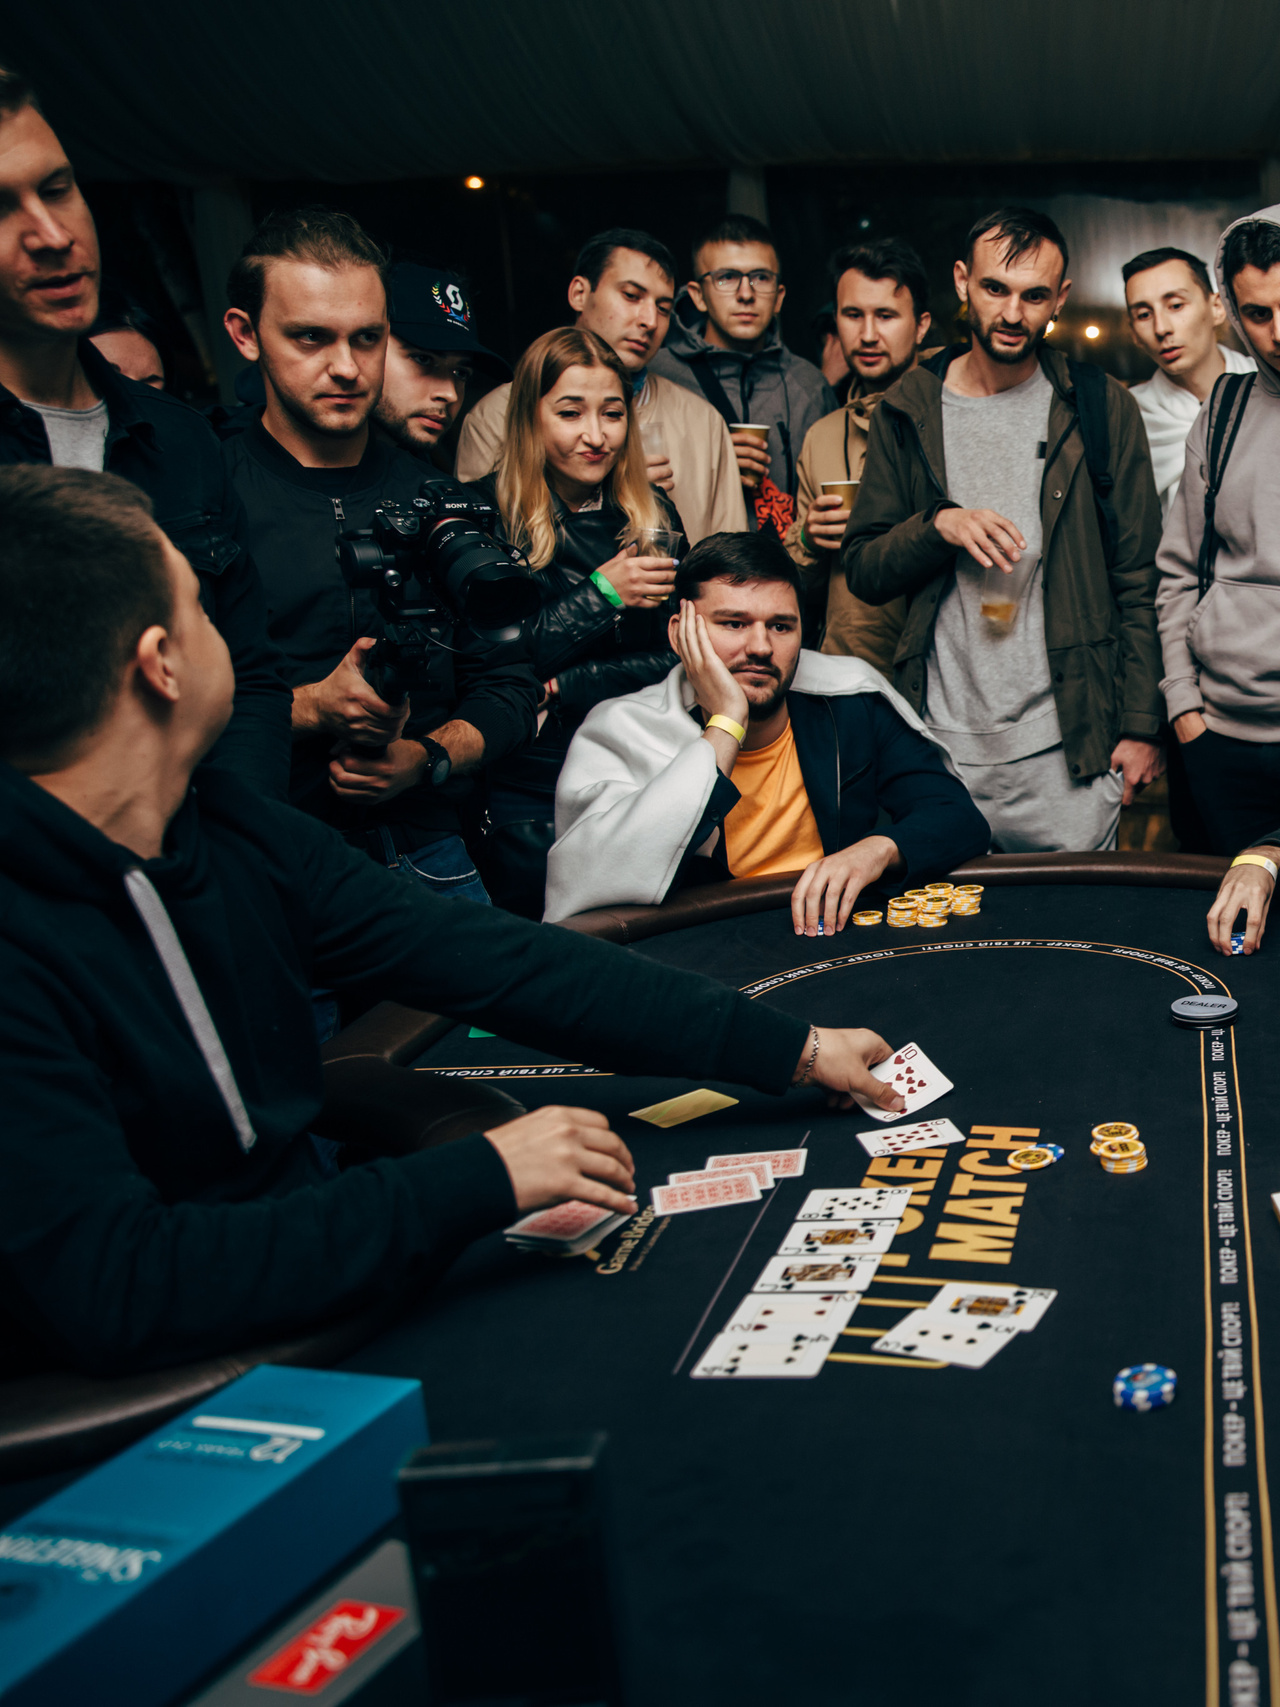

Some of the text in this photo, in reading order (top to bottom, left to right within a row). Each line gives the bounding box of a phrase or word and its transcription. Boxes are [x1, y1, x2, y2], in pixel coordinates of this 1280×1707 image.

[1181, 1000, 1227, 1009] DEALER
[901, 1045, 918, 1060] 10
[1211, 1041, 1224, 1061] ПОКЕР
[1216, 1112, 1233, 1122] ЦЕ
[1216, 1129, 1231, 1156] ПОКЕР
[928, 1125, 1041, 1265] MATCH
[1218, 1224, 1238, 1238] ЦЕ
[1219, 1247, 1238, 1284] ПОКЕР
